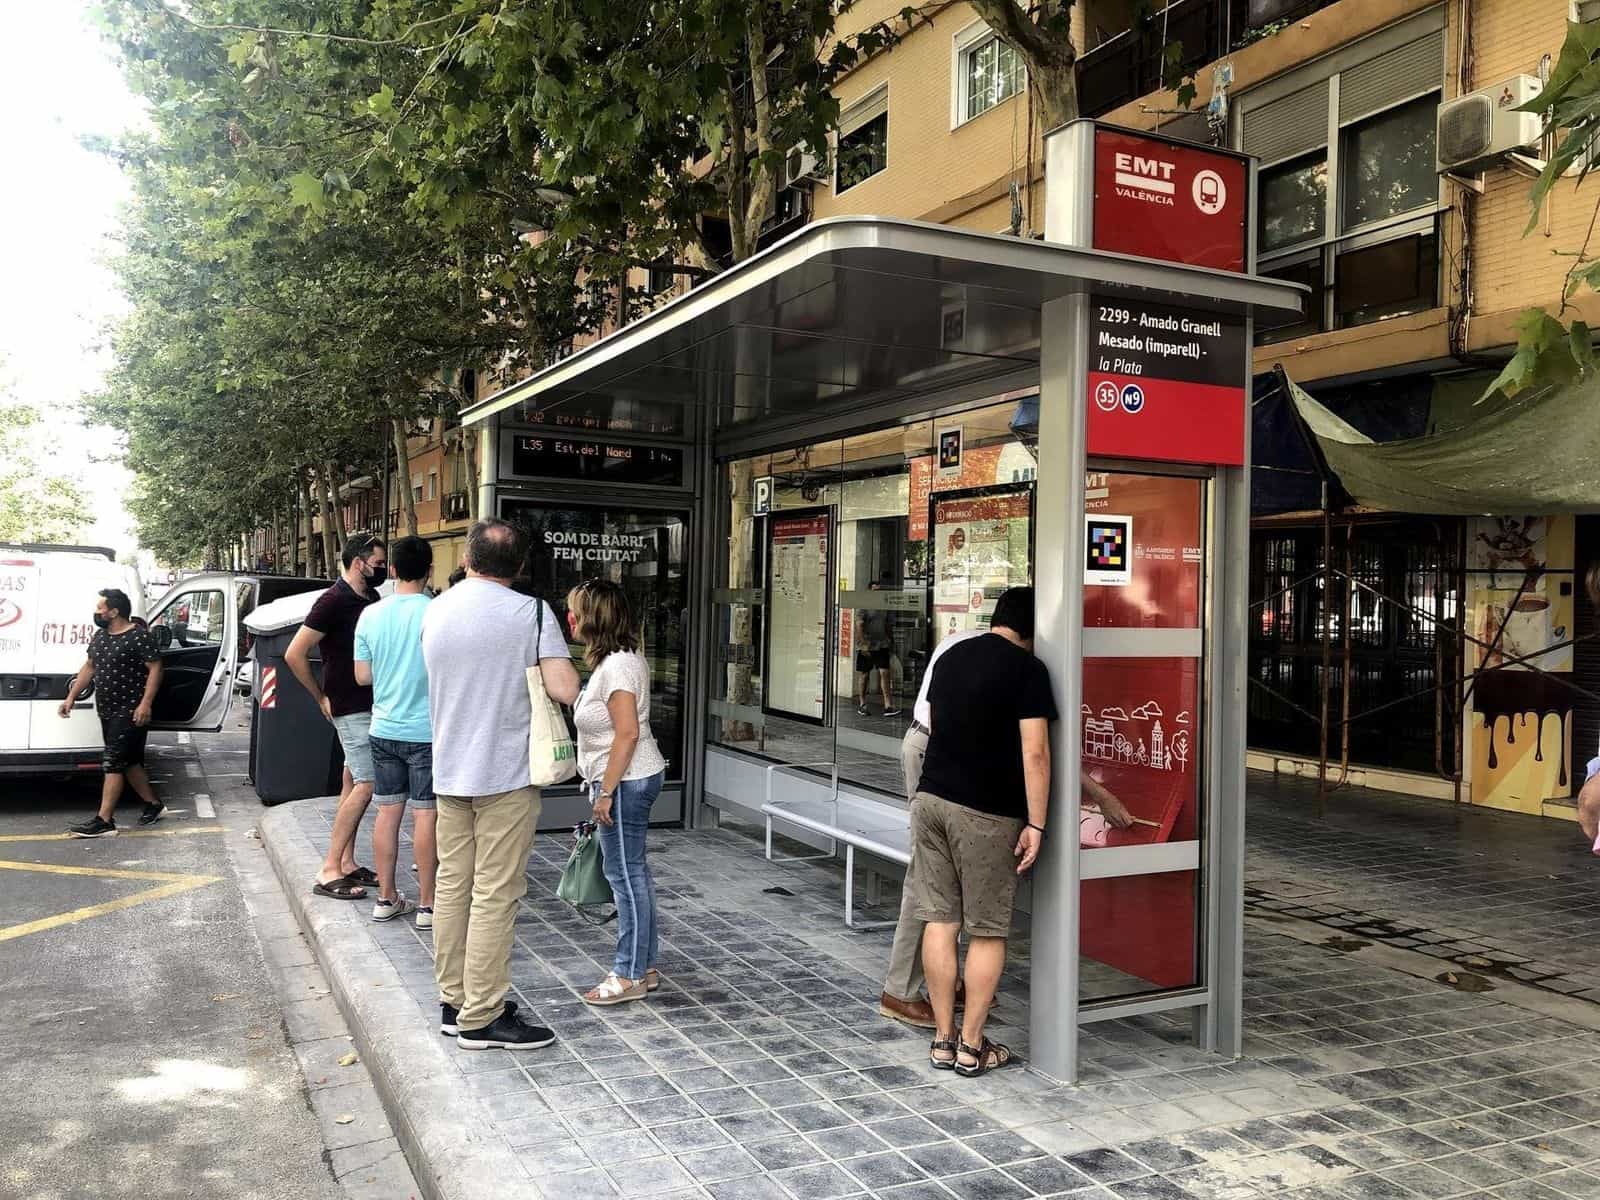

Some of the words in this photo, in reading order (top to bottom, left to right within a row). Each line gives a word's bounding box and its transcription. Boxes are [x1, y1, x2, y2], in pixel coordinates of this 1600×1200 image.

[1115, 152, 1176, 179] EMT
[1115, 187, 1174, 206] VALÈNCIA
[1099, 306, 1130, 324] 2299
[1139, 312, 1179, 331] Amado
[1181, 318, 1221, 337] Granell
[1098, 331, 1144, 351] Mesado
[1145, 336, 1200, 360] (imparell)
[1098, 355, 1110, 371] la
[1113, 358, 1143, 375] Plata
[1099, 388, 1115, 404] 35
[1124, 391, 1140, 406] N9
[522, 439, 544, 451] L35
[1085, 472, 1109, 487] MT
[757, 482, 769, 512] P
[543, 531, 578, 545] SOM
[579, 533, 600, 546] DE
[601, 534, 648, 549] BARRI,
[553, 547, 584, 560] FEM
[585, 548, 640, 562] CIUTAT
[0, 575, 26, 592] AS
[42, 622, 66, 645] 671
[70, 623, 94, 645] 543
